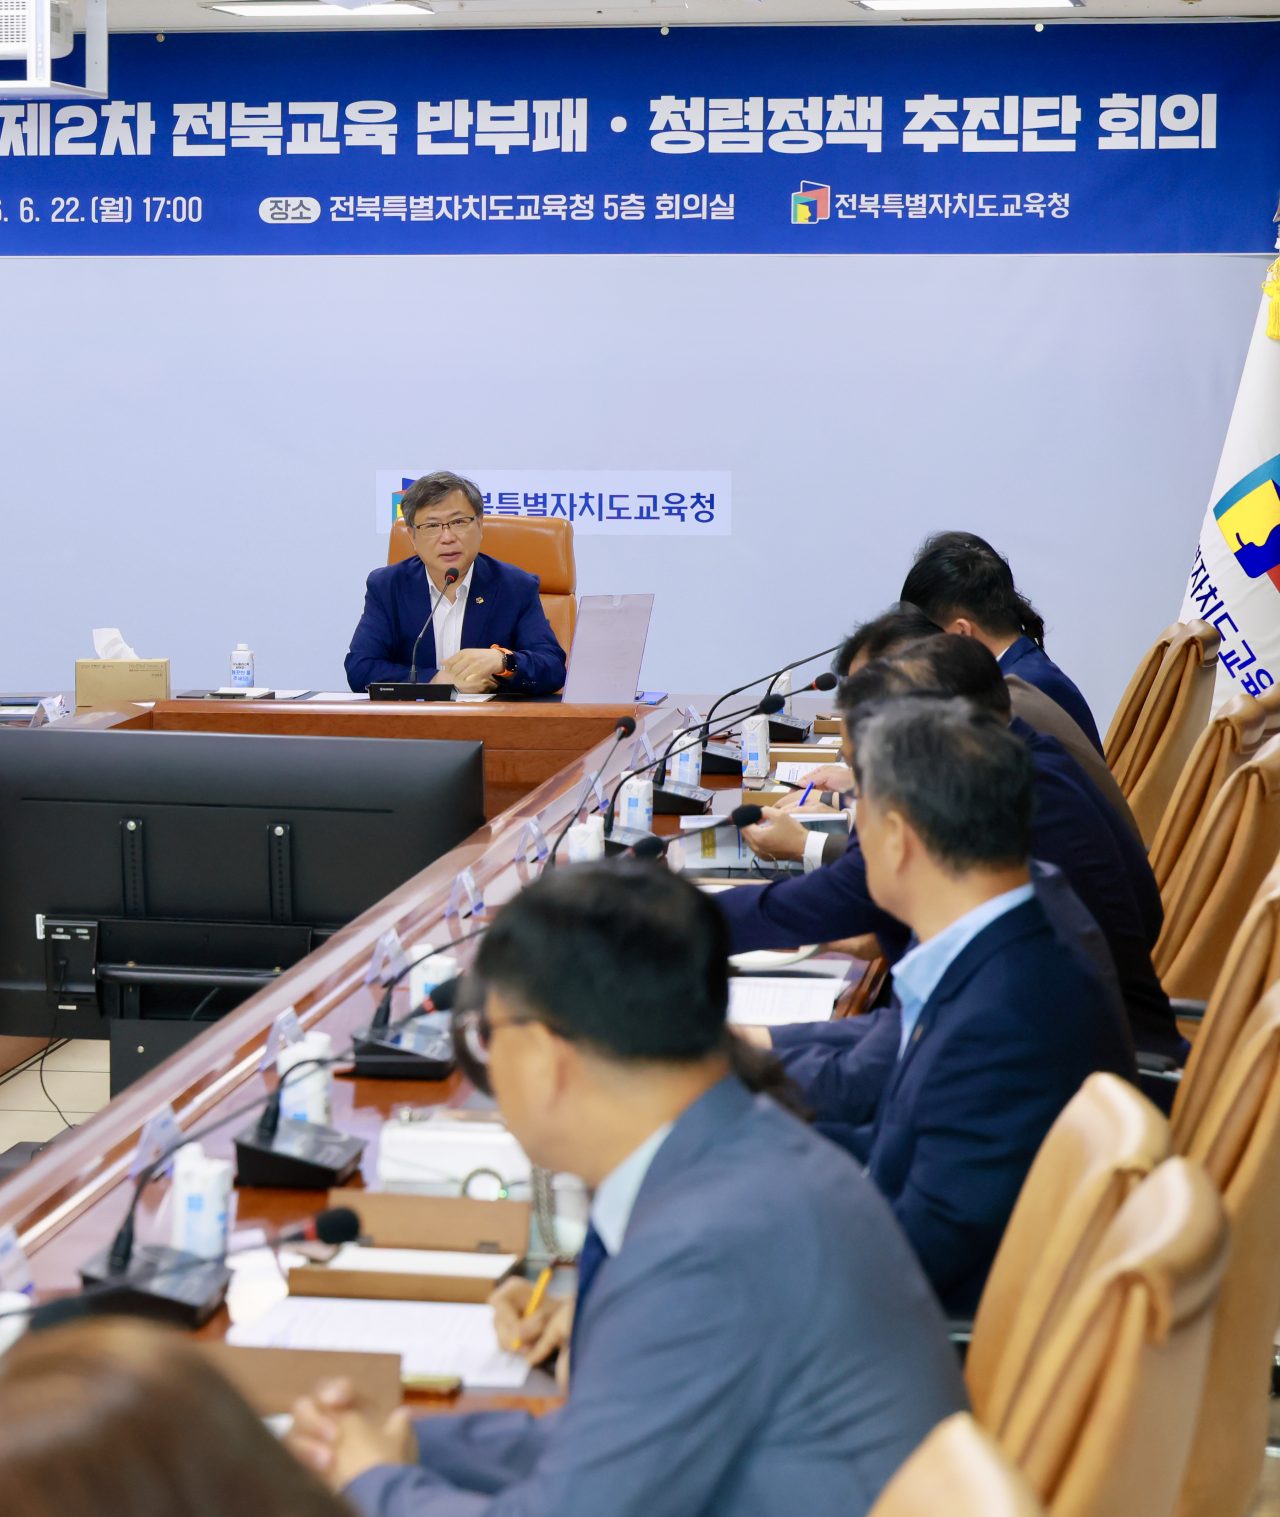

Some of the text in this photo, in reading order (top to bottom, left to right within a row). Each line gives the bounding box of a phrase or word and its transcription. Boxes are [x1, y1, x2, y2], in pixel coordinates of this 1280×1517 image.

[172, 100, 398, 157] 전북교육
[416, 97, 588, 156] 반부패
[648, 94, 883, 155] 청렴정책
[902, 94, 1082, 153] 추진단
[1097, 92, 1217, 150] 회의
[19, 196, 40, 223] 6.
[142, 195, 203, 223] 17:00
[269, 193, 735, 222] 장소 전북특별자치도교육청 5층 회의실
[834, 192, 1070, 220] 전북특별자치도교육청
